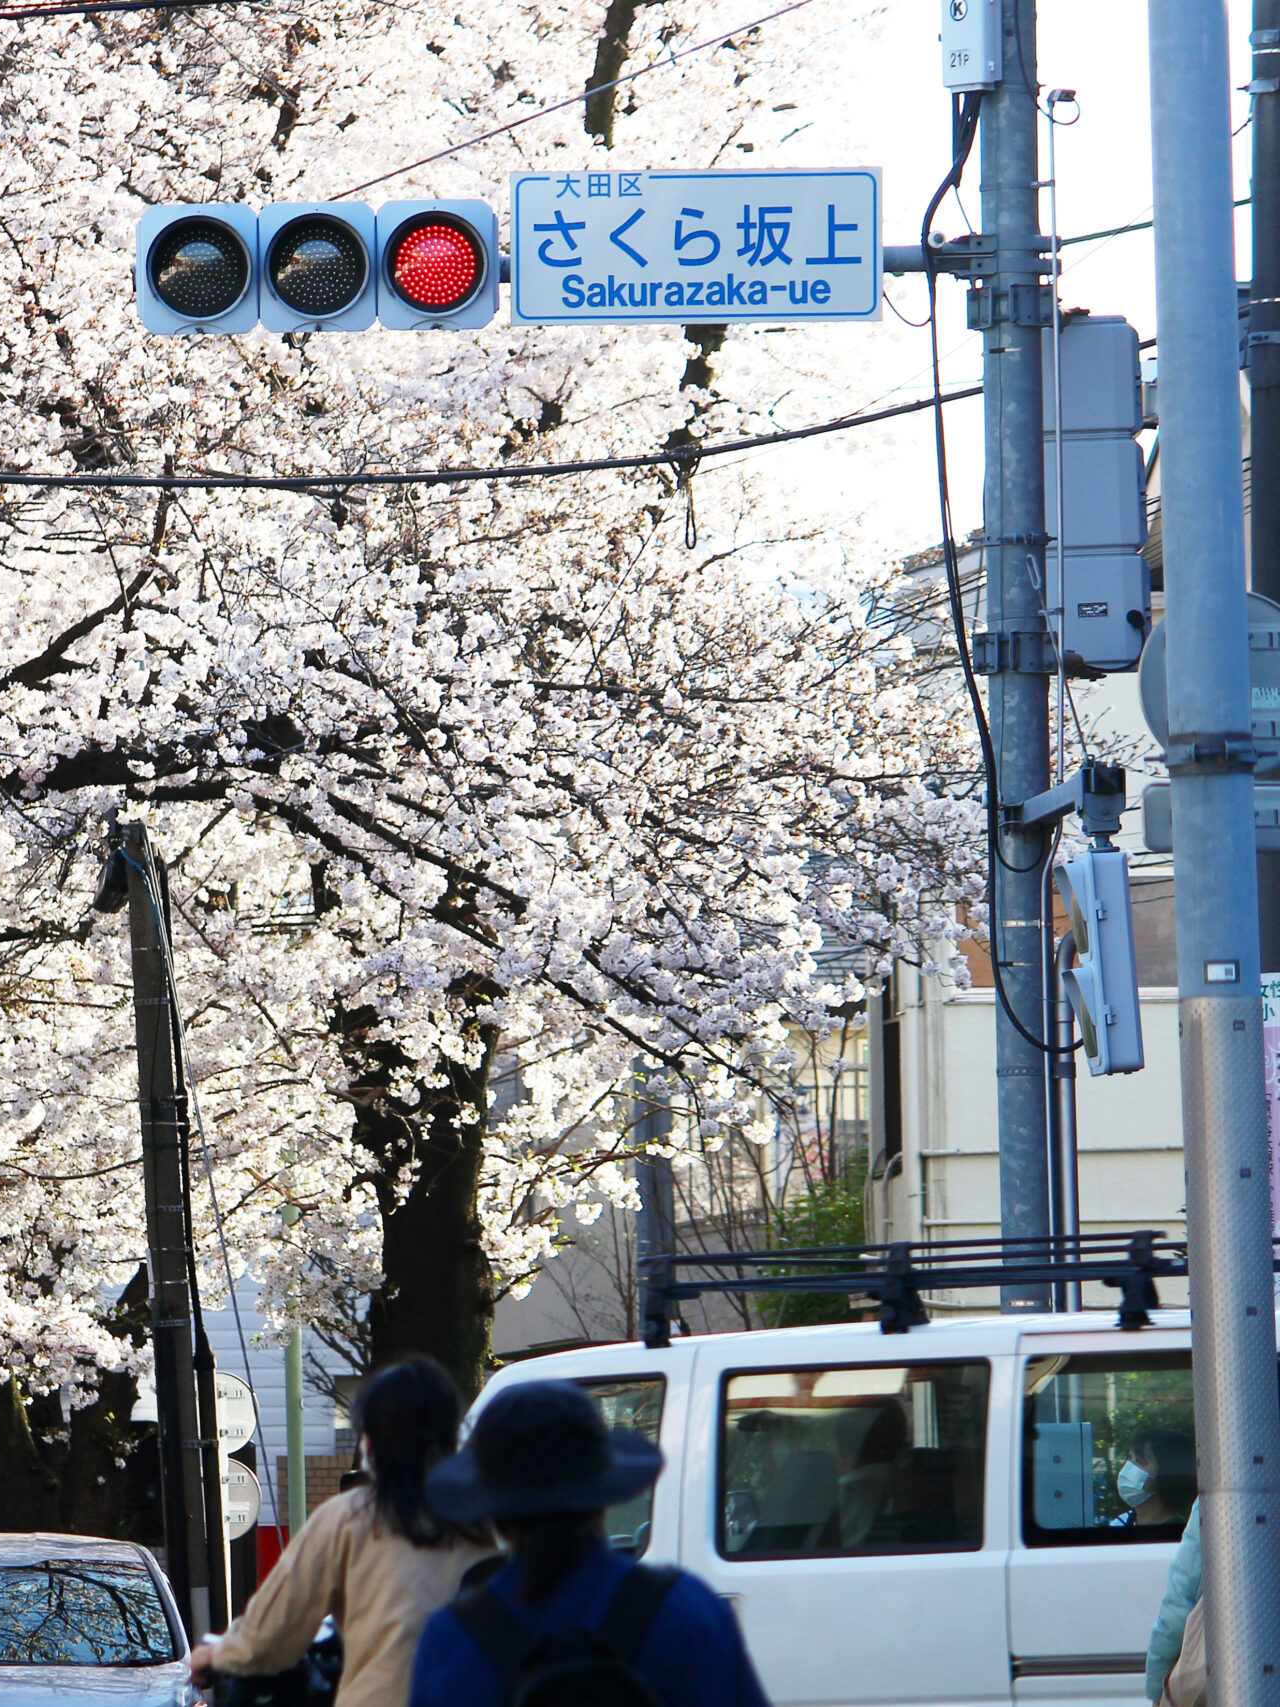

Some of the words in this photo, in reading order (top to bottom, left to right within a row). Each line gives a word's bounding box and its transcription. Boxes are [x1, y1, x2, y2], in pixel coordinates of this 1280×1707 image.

[950, 53, 970, 68] 21P
[556, 173, 643, 199] 大田区
[533, 204, 862, 268] さくら坂上
[561, 273, 832, 309] Sakurazaka-ue
